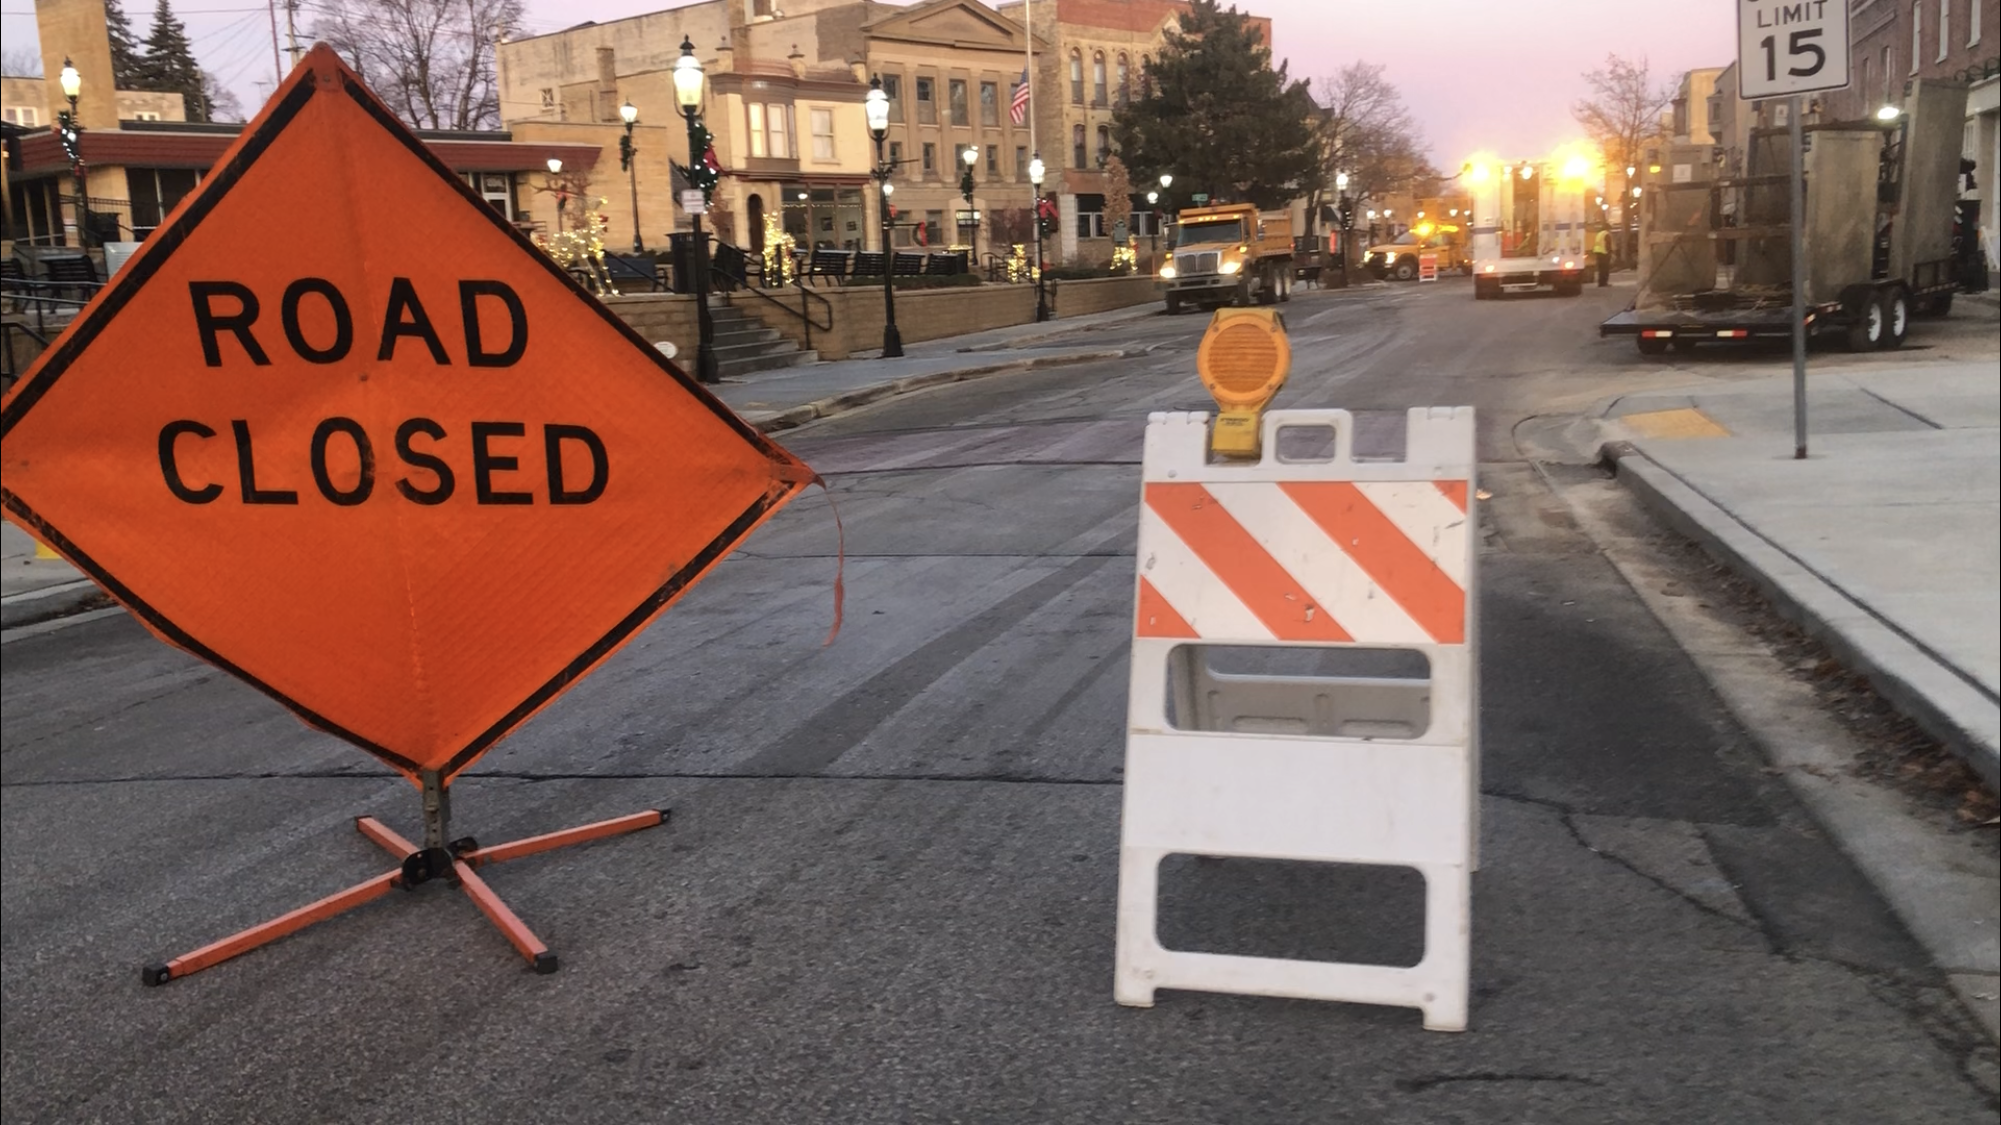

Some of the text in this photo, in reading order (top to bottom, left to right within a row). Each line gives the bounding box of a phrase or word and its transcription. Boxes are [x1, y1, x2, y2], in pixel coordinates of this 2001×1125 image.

[1757, 0, 1828, 28] LIMIT
[1760, 28, 1826, 81] 15
[188, 277, 528, 368] ROAD
[158, 417, 609, 506] CLOSED
